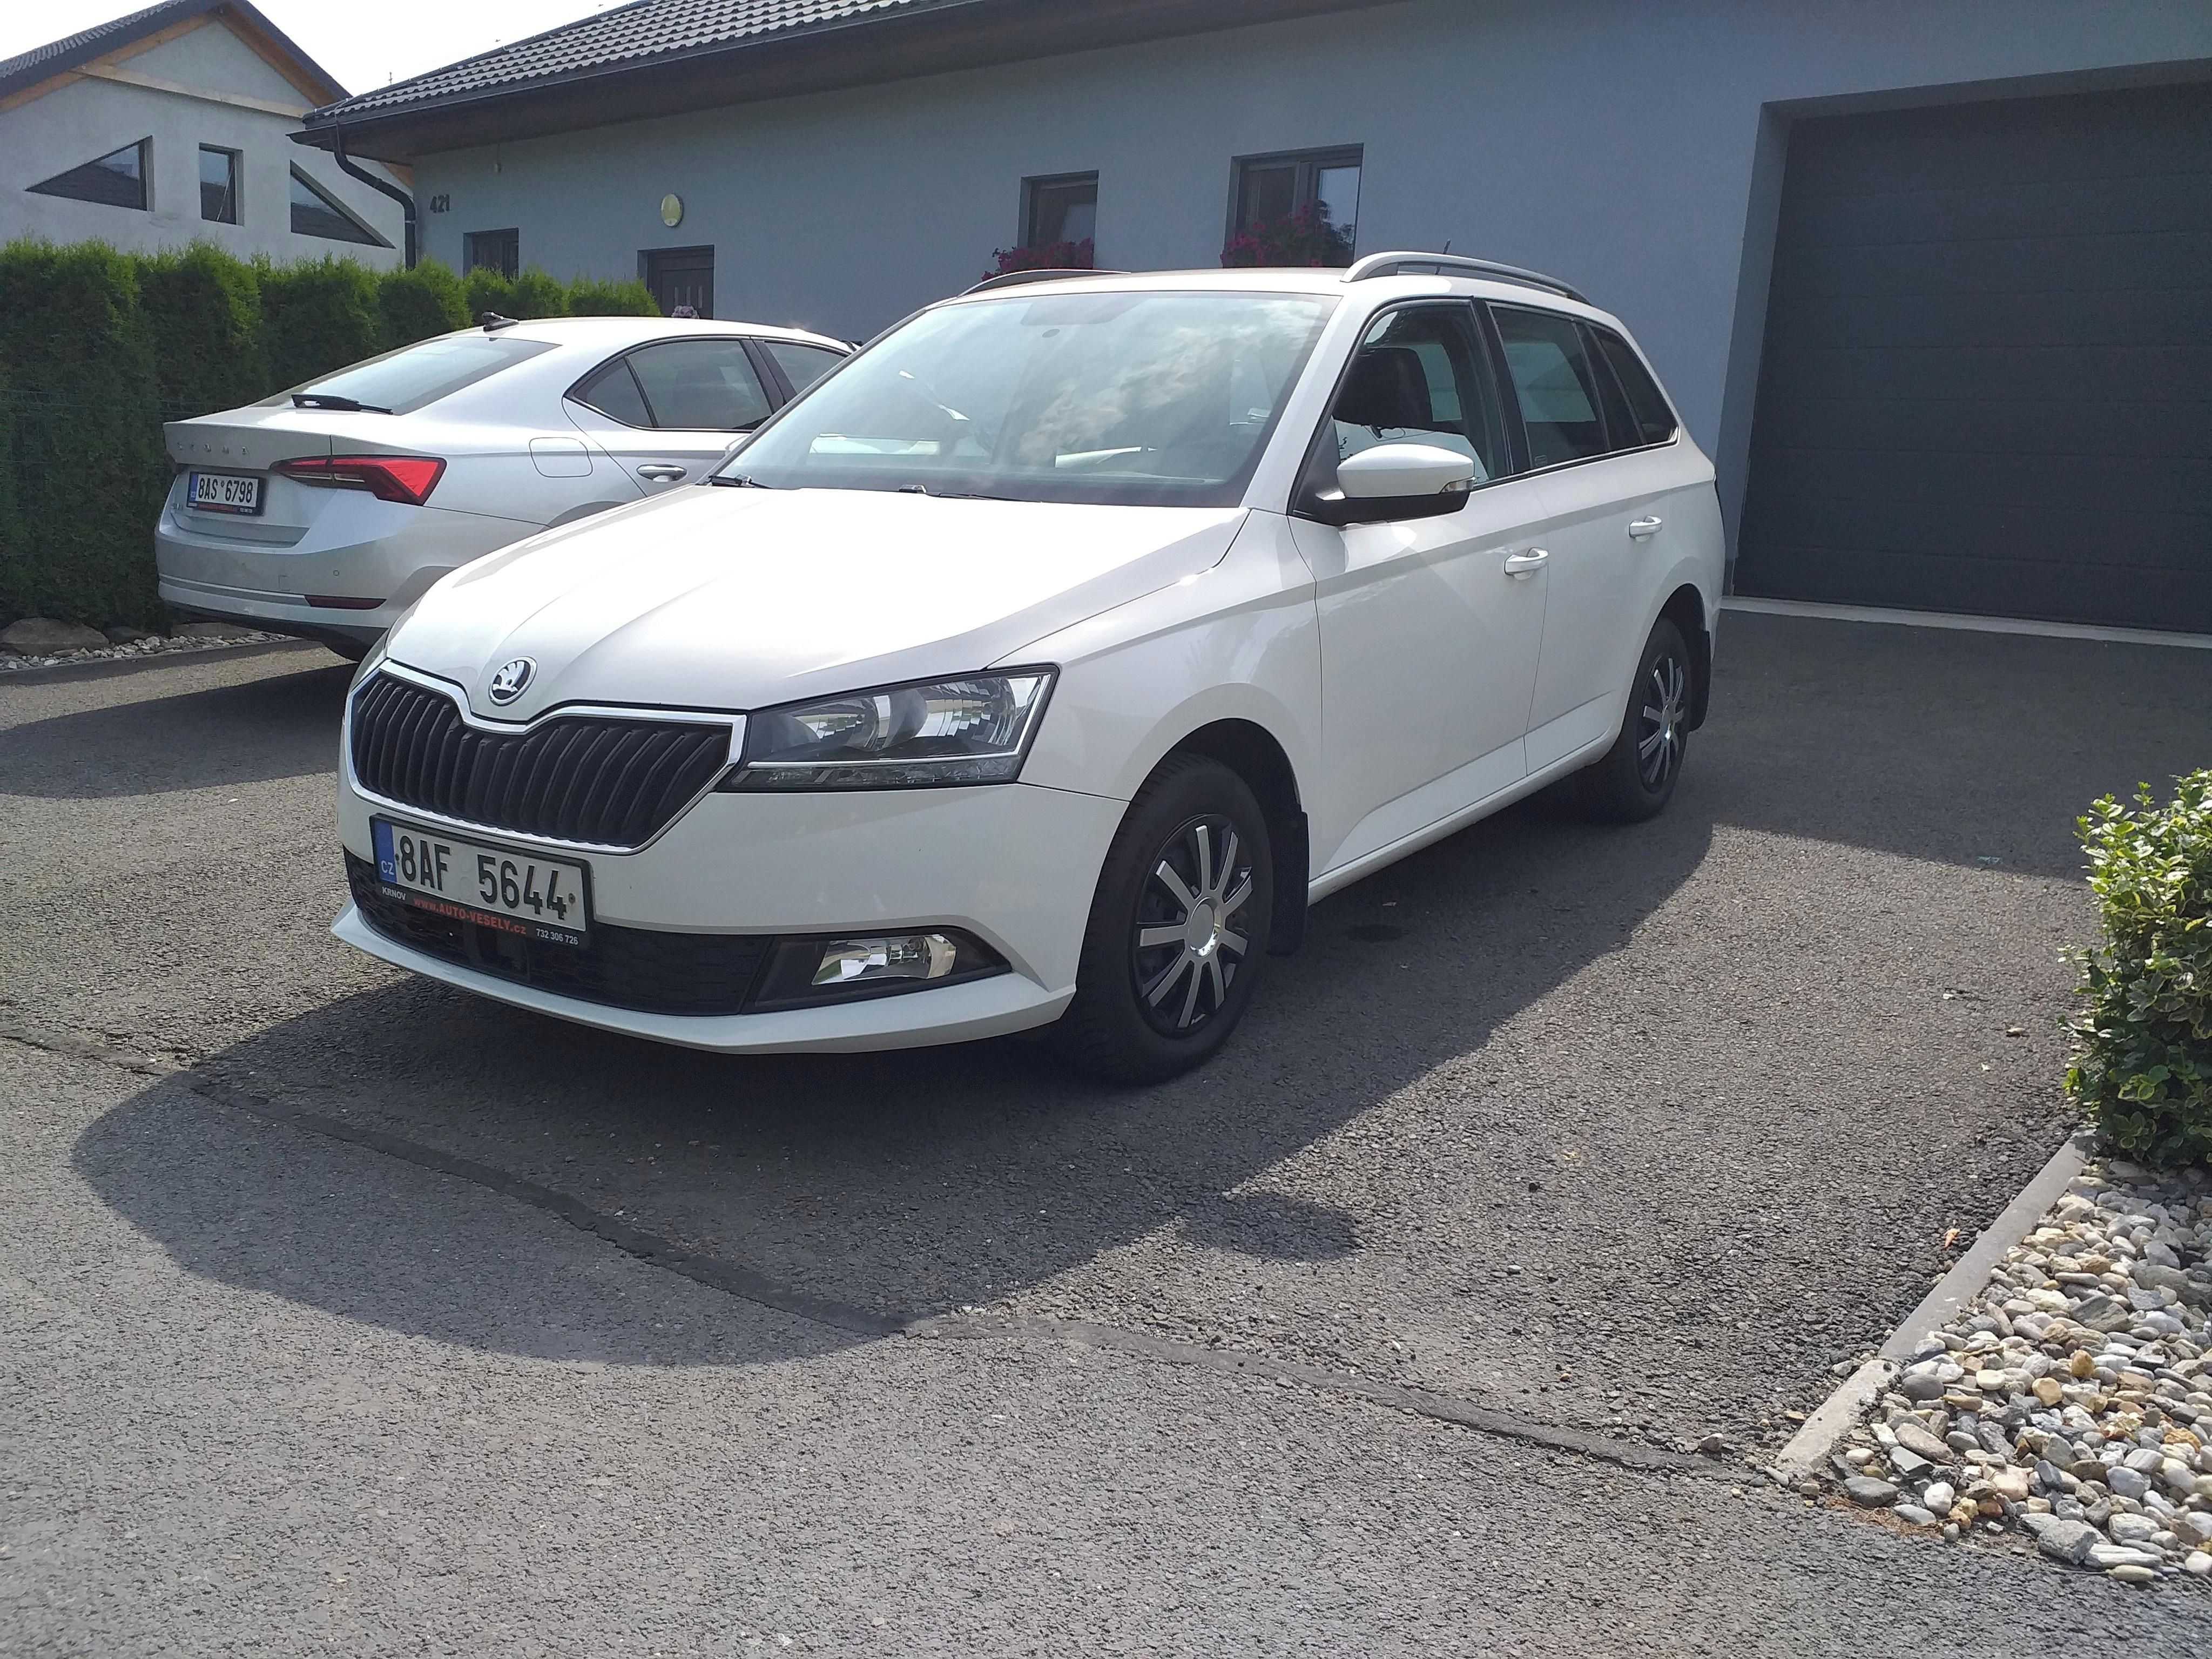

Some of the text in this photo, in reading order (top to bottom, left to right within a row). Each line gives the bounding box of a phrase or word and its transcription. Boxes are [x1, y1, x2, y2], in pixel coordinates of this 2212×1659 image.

[430, 194, 450, 213] 421
[198, 477, 253, 503] 8AS 6798
[381, 860, 395, 875] CZ
[400, 835, 567, 920] 8AF 5644
[382, 886, 527, 935] KRNOV www.AUTO-VESELY.cz
[536, 928, 579, 946] 732 306 726
